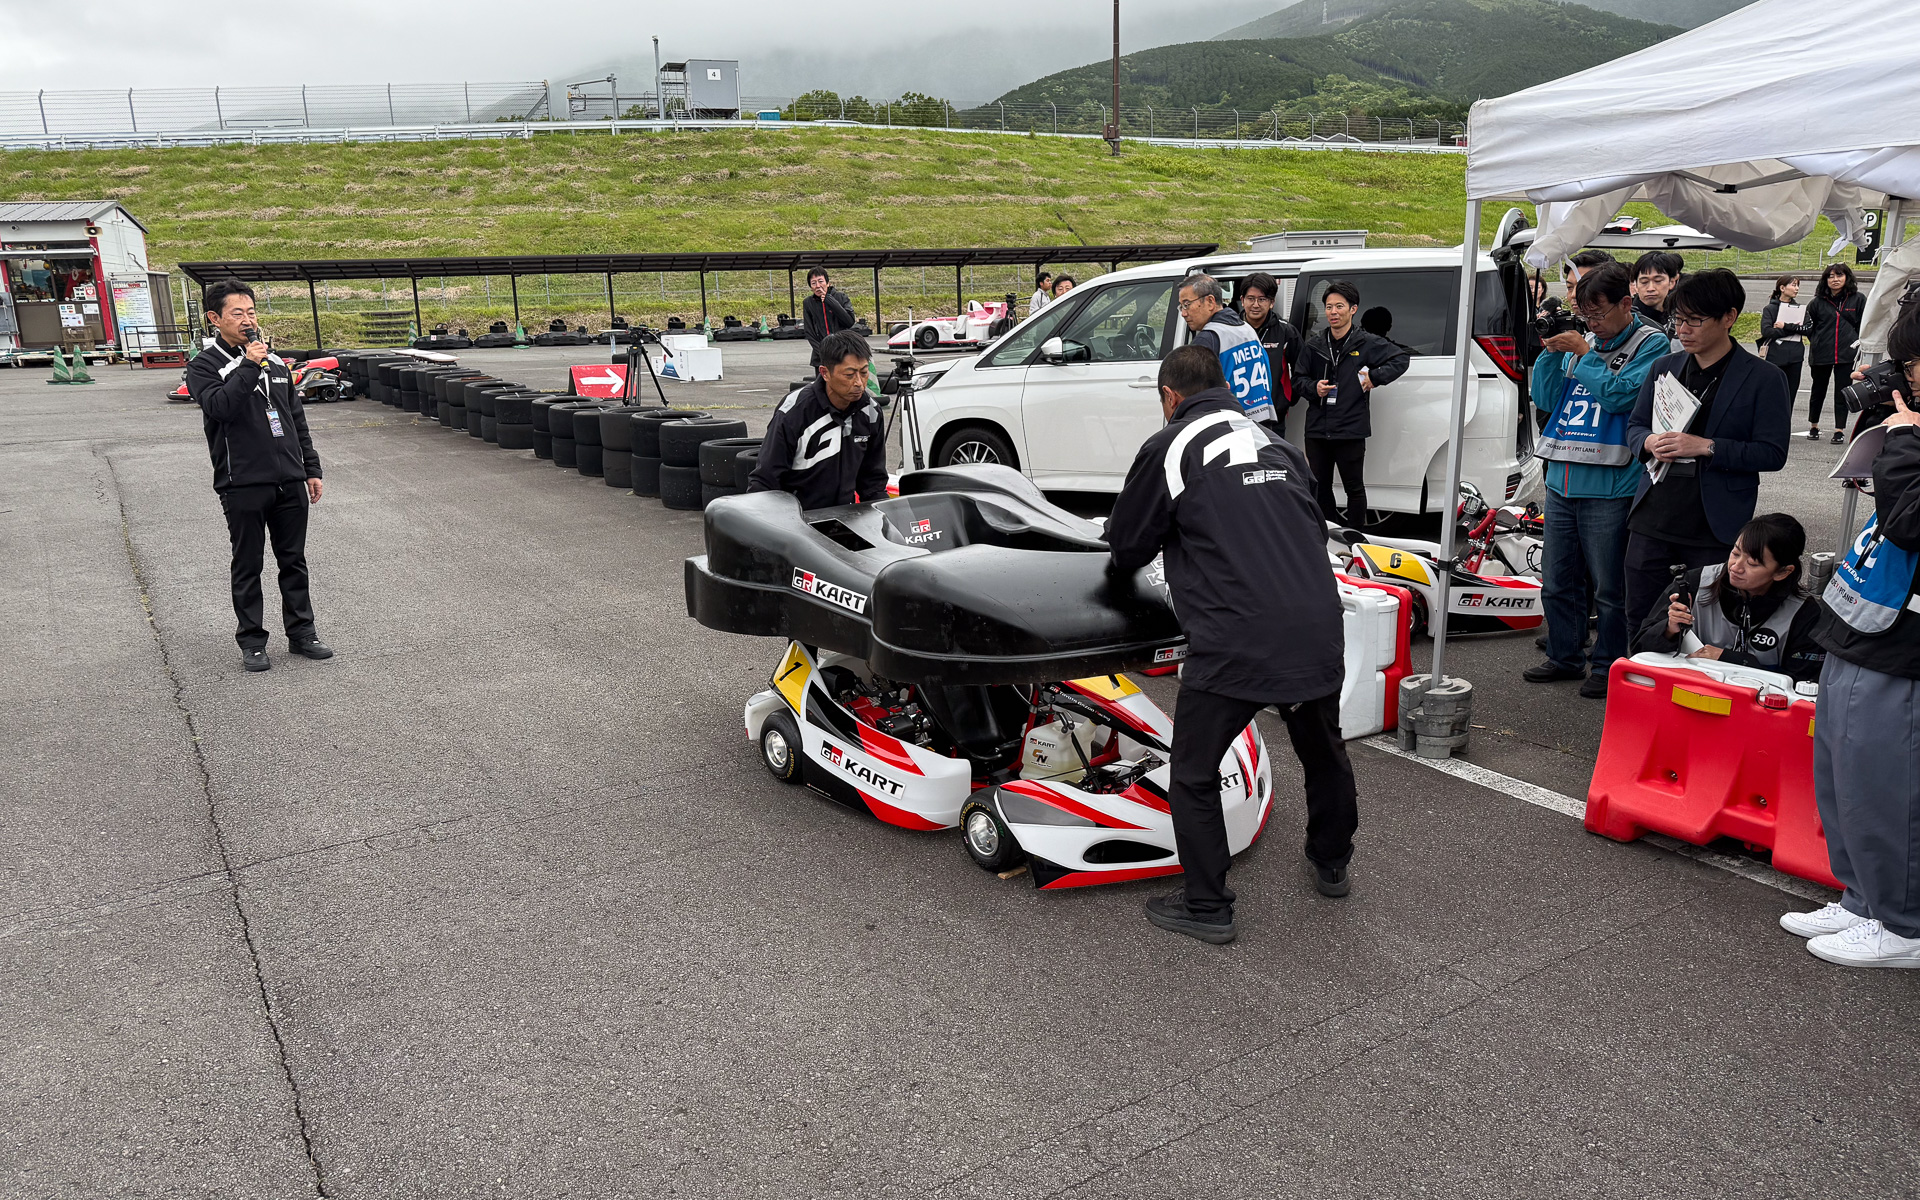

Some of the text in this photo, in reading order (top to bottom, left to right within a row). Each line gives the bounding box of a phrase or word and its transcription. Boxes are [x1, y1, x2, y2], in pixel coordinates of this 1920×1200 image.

[1866, 214, 1875, 225] P
[911, 521, 931, 535] GR
[905, 530, 943, 545] KART
[1390, 553, 1402, 569] 6
[793, 573, 865, 610] GR KART
[1458, 595, 1536, 609] GR KART
[1752, 633, 1776, 647] 530
[1156, 651, 1173, 660] GR
[779, 661, 803, 682] 1
[1037, 740, 1056, 749] KART
[821, 745, 842, 767] GR
[844, 758, 904, 795] KART
